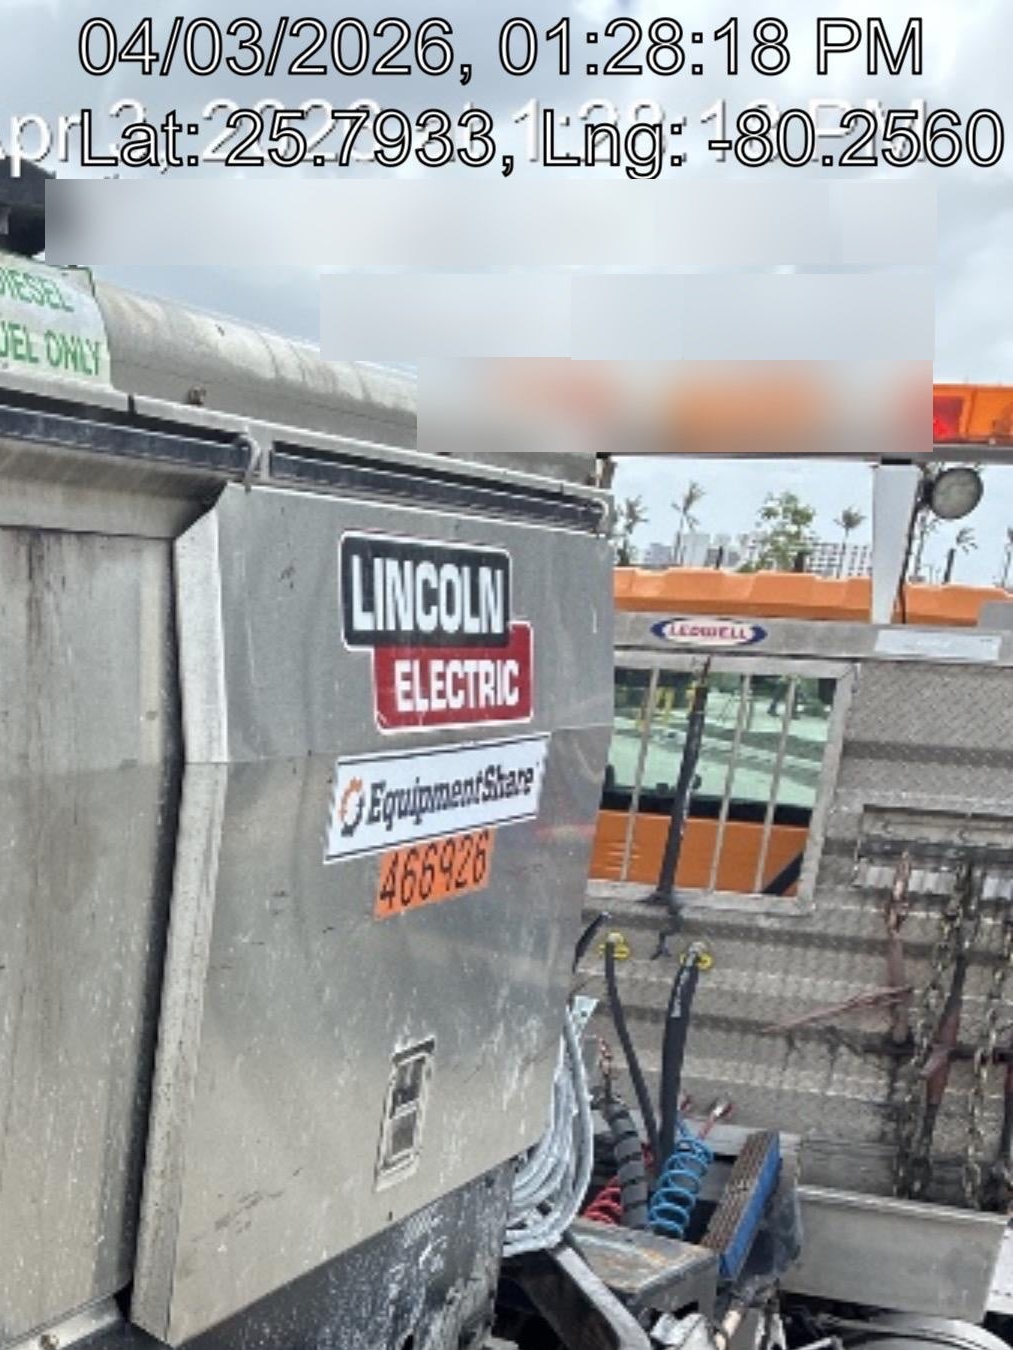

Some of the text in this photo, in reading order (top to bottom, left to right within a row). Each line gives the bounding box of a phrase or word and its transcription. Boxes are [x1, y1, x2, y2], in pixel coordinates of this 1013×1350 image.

[44, 328, 101, 376] ONLY
[351, 554, 505, 634] LINCOLN
[394, 659, 519, 713] ELECTRIC
[365, 763, 536, 827] EquipmentShare
[379, 831, 489, 906] 466926
